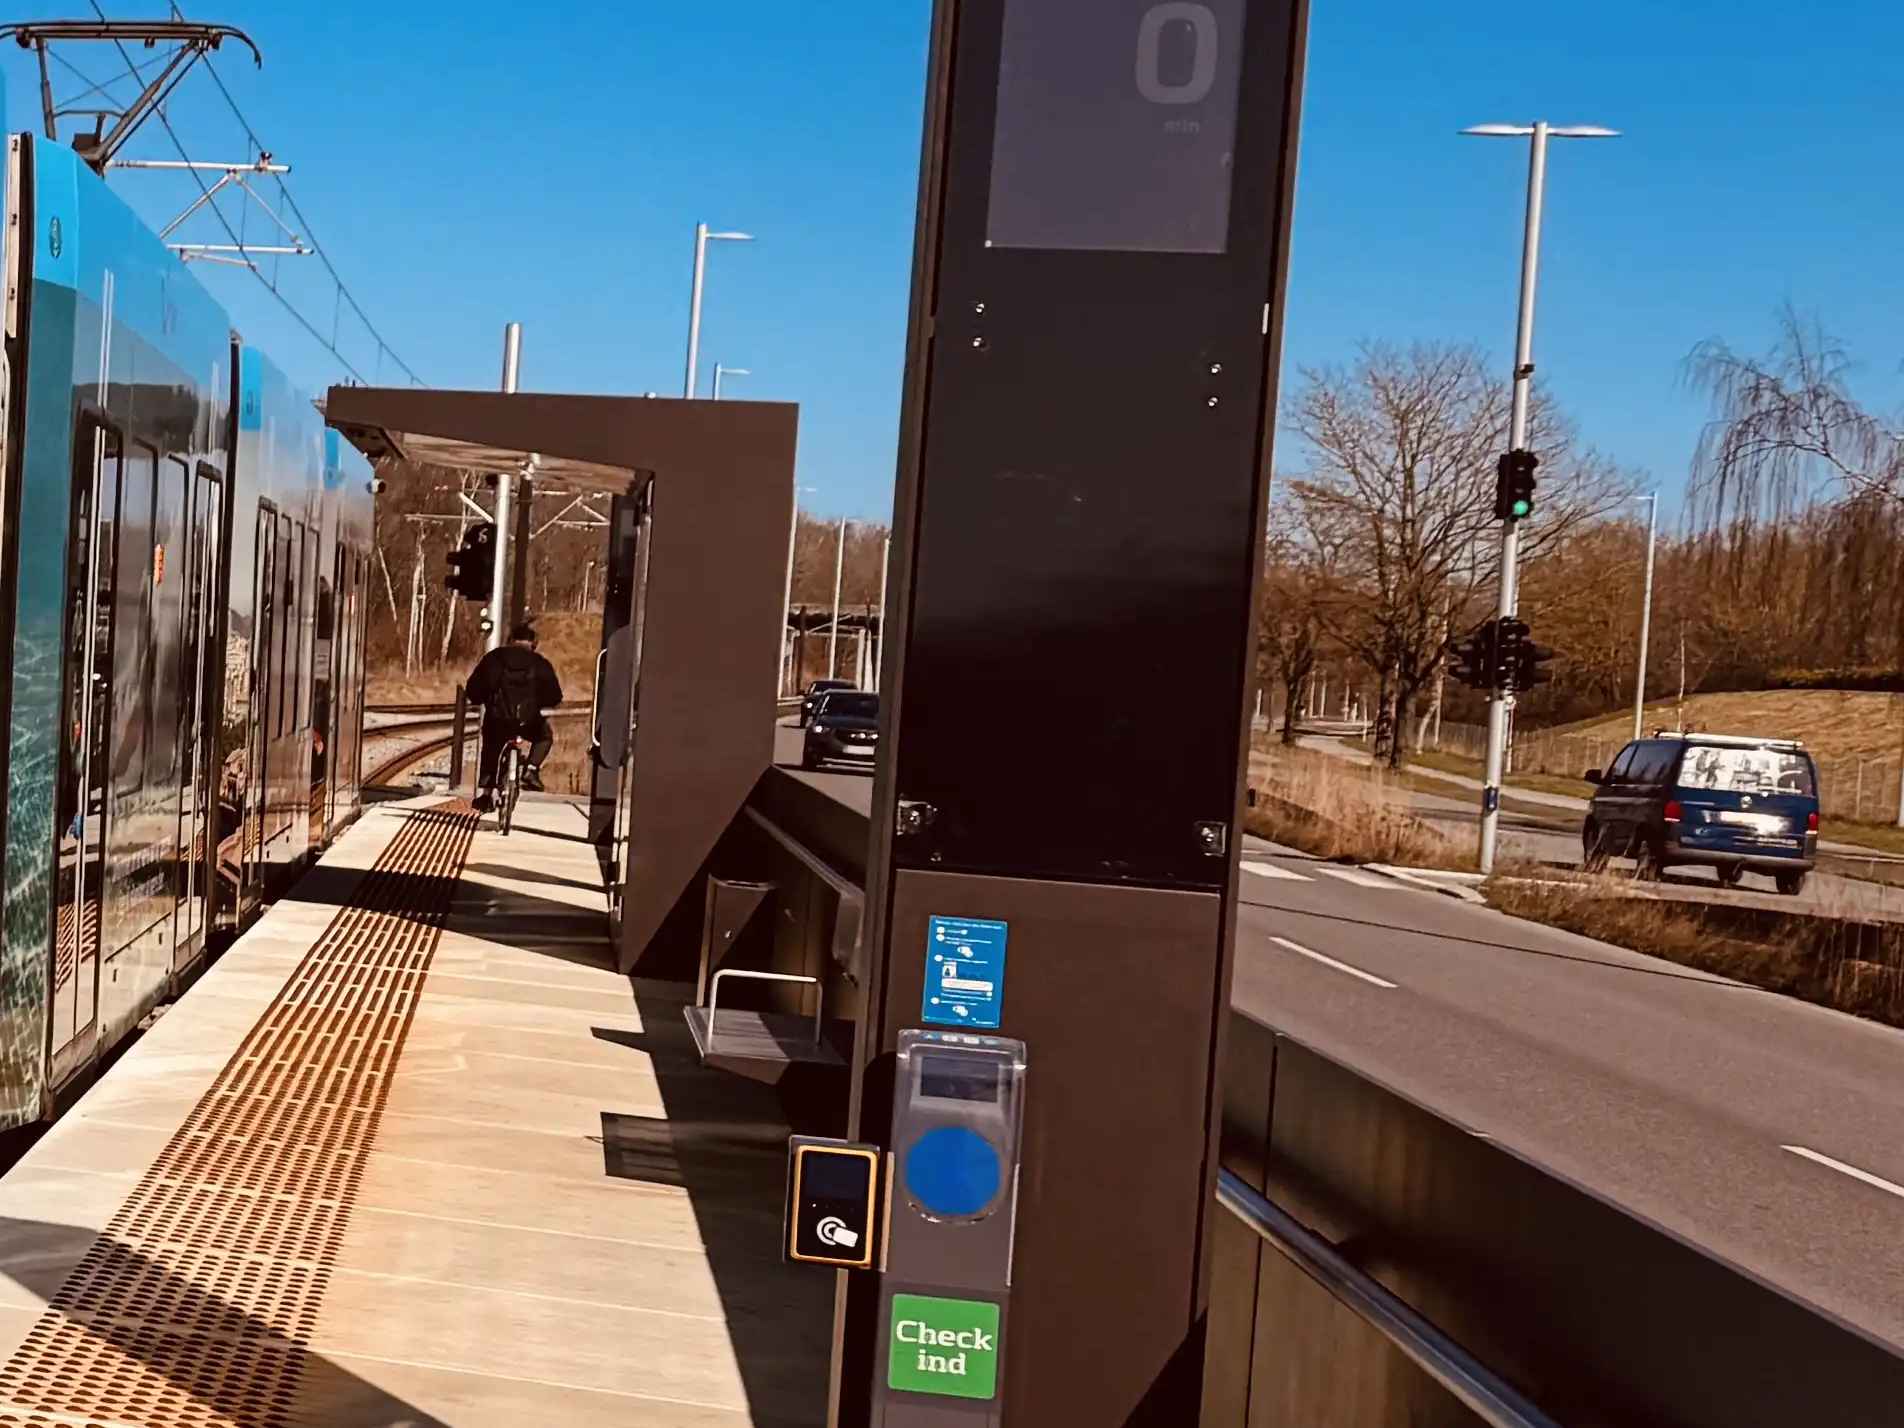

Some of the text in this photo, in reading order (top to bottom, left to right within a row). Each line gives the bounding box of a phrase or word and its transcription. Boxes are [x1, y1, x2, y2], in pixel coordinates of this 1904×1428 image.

[1136, 1, 1218, 104] 0
[896, 1320, 993, 1351] Check
[917, 1349, 967, 1375] ind
